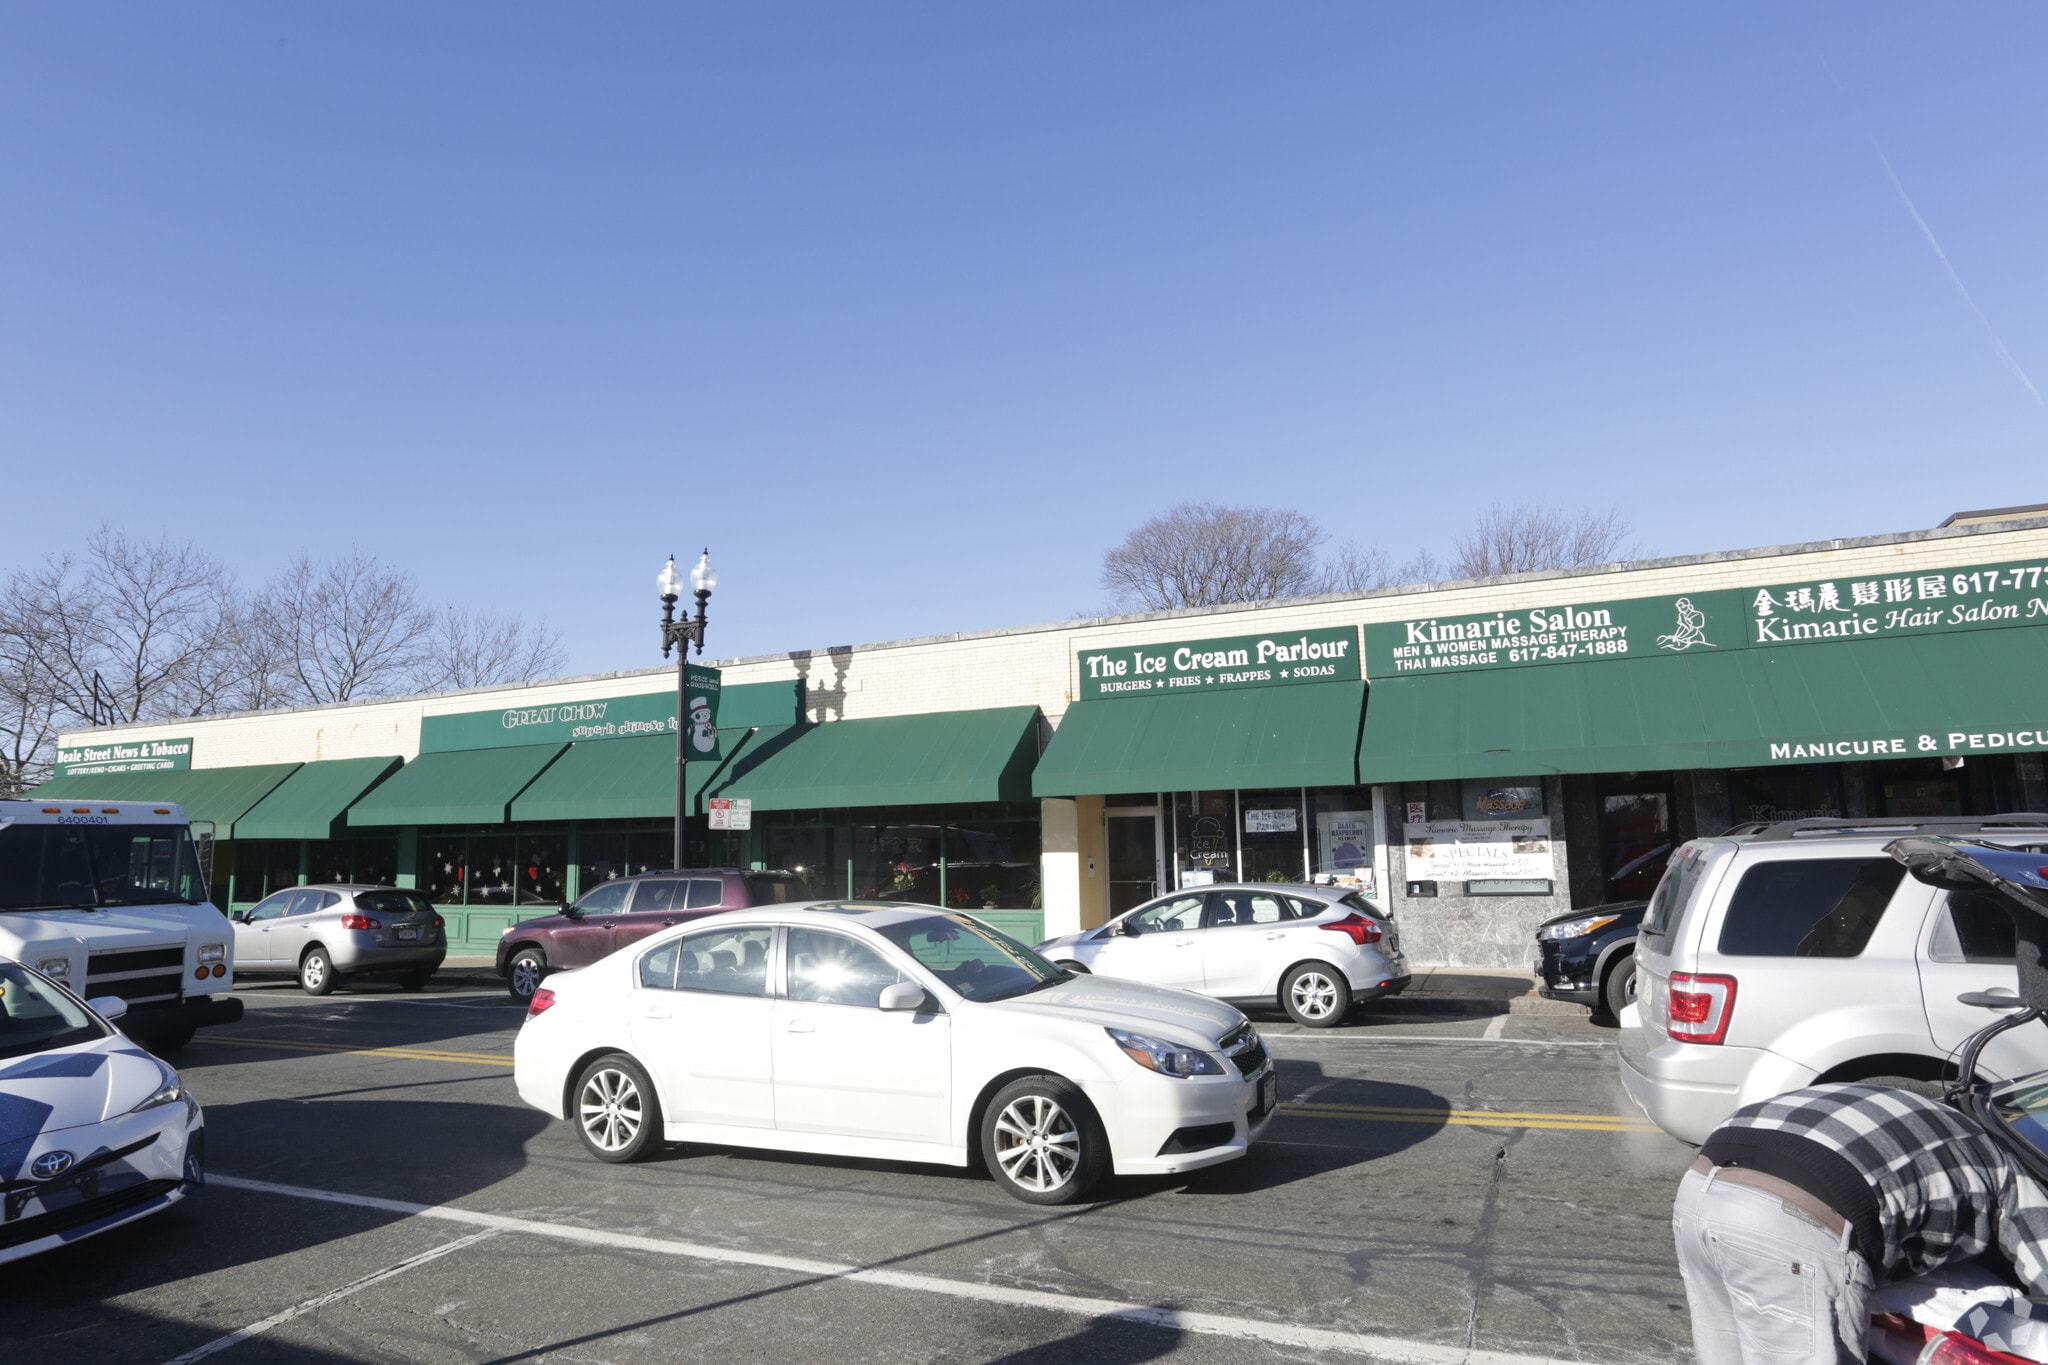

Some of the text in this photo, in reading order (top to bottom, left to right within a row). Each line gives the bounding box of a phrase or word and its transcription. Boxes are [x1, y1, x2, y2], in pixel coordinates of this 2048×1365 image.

[1405, 607, 1611, 645] Kimarie Salon
[1755, 613, 1878, 642] Kimarie
[1885, 606, 1943, 629] Hair
[1948, 600, 2019, 625] Salon
[1393, 626, 1628, 658] MEN & WOMEN MASSAGE THERAPY
[1087, 637, 1349, 678] The Ice Cream Parlour
[1395, 639, 1628, 671] THAI MASSAGE 617-847-1888
[1100, 665, 1335, 693] BURGERS FRIES FRAPPES SODAS
[502, 702, 607, 728] GREAT CHOW
[572, 722, 615, 737] superb
[618, 720, 664, 734] chinese
[57, 742, 189, 763] Beale Street News & Tobacco
[1770, 730, 2048, 760] MANICURE & PEDICU
[130, 763, 155, 771] GREETING
[156, 761, 174, 769] CARDS
[1477, 795, 1526, 812] Massage
[57, 816, 108, 824] 6400401
[1425, 822, 1533, 833] Kimarie Massage Therapy
[1190, 850, 1227, 860] Cream
[1192, 840, 1210, 849] Ice
[1442, 846, 1509, 860] SPECIALS
